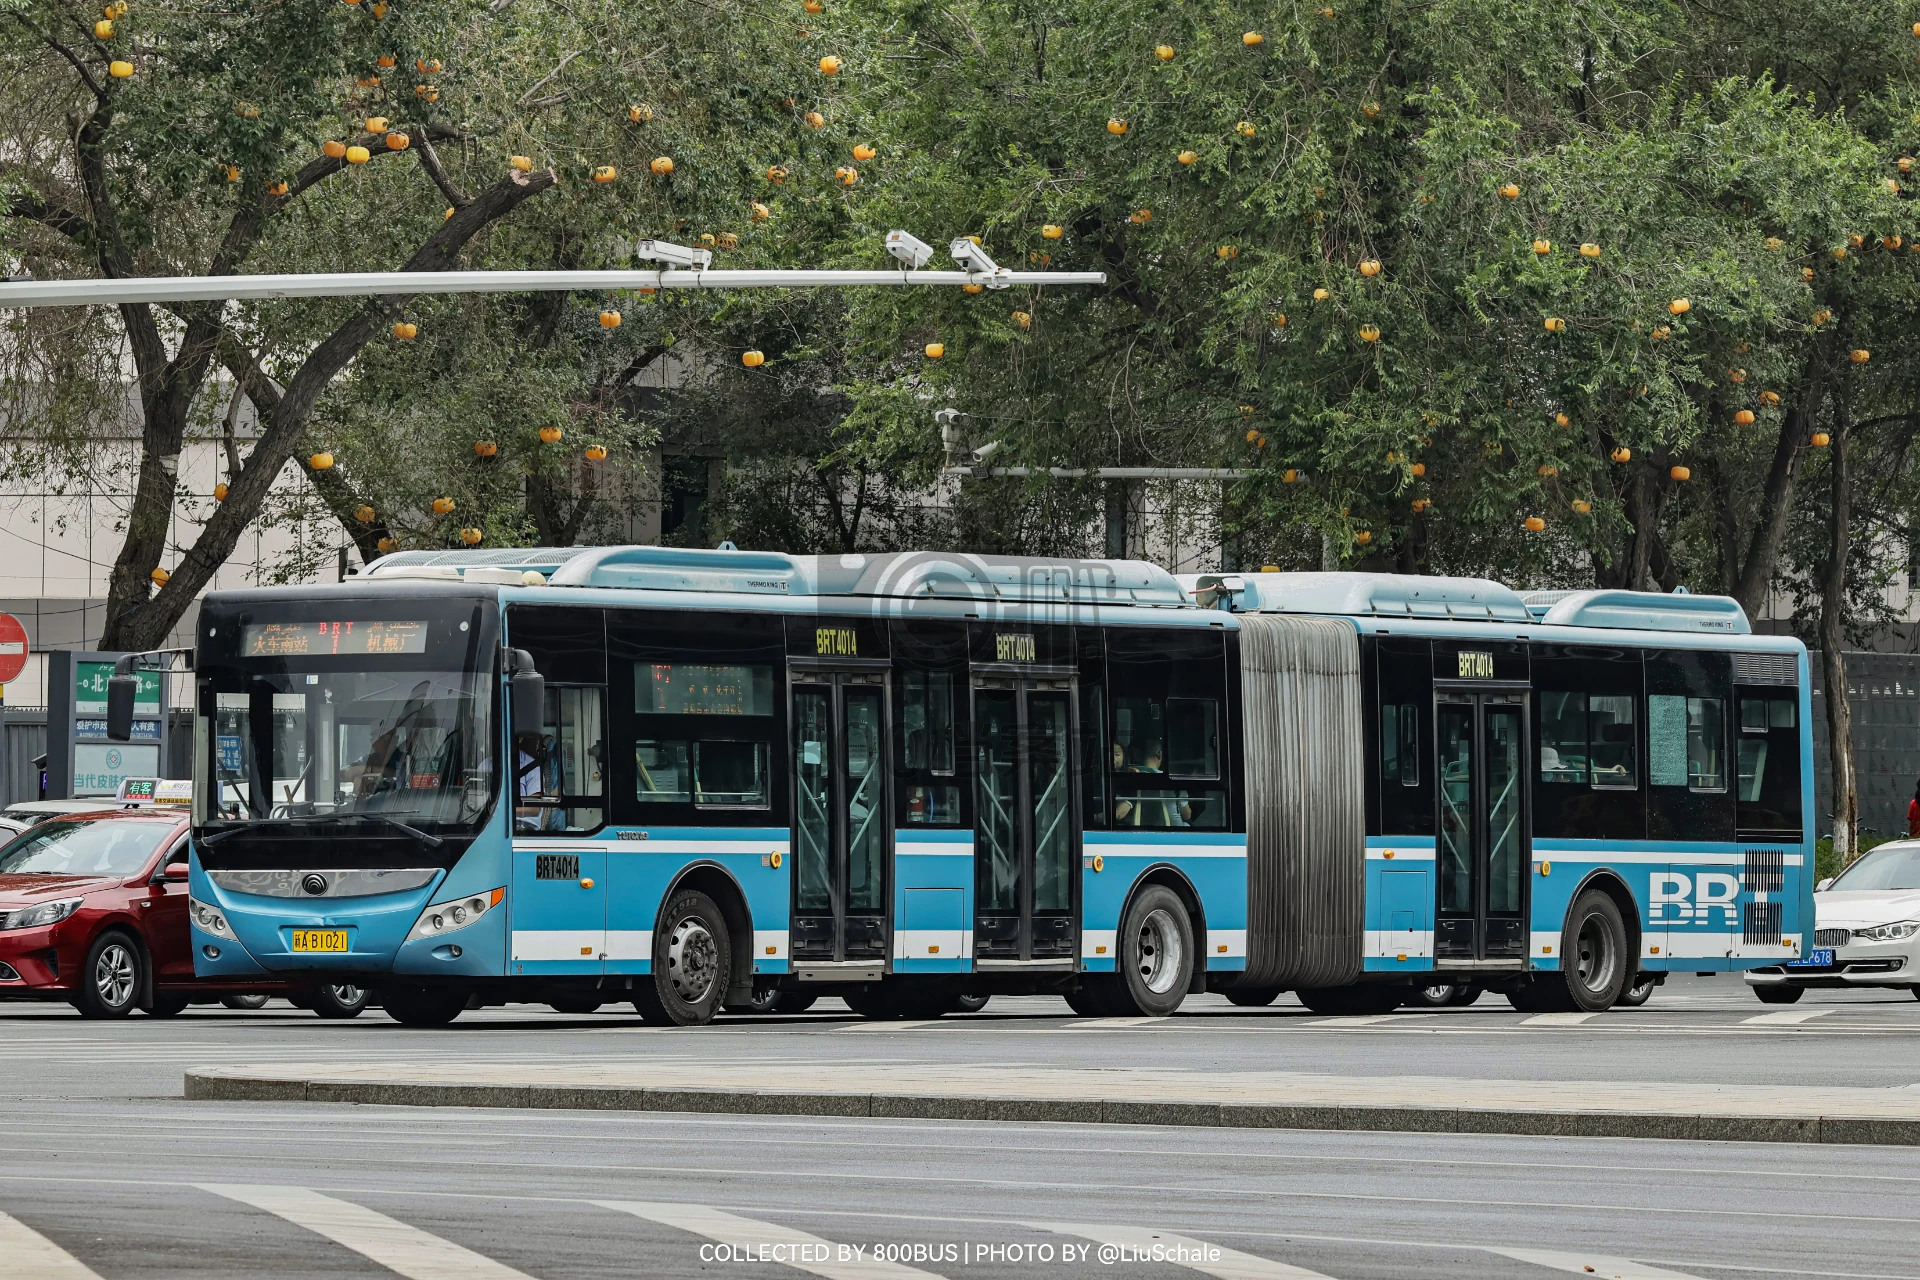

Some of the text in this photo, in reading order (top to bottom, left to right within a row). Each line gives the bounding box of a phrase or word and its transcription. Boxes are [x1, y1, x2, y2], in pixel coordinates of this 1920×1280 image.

[318, 621, 354, 636] BRT
[816, 628, 857, 655] BRT4014
[996, 635, 1035, 661] BRT4014
[1458, 653, 1494, 677] BRT4014
[129, 782, 152, 795] 有客
[616, 831, 649, 841] YUTONG
[536, 855, 579, 879] BRT4014
[1648, 872, 1785, 926] BRT
